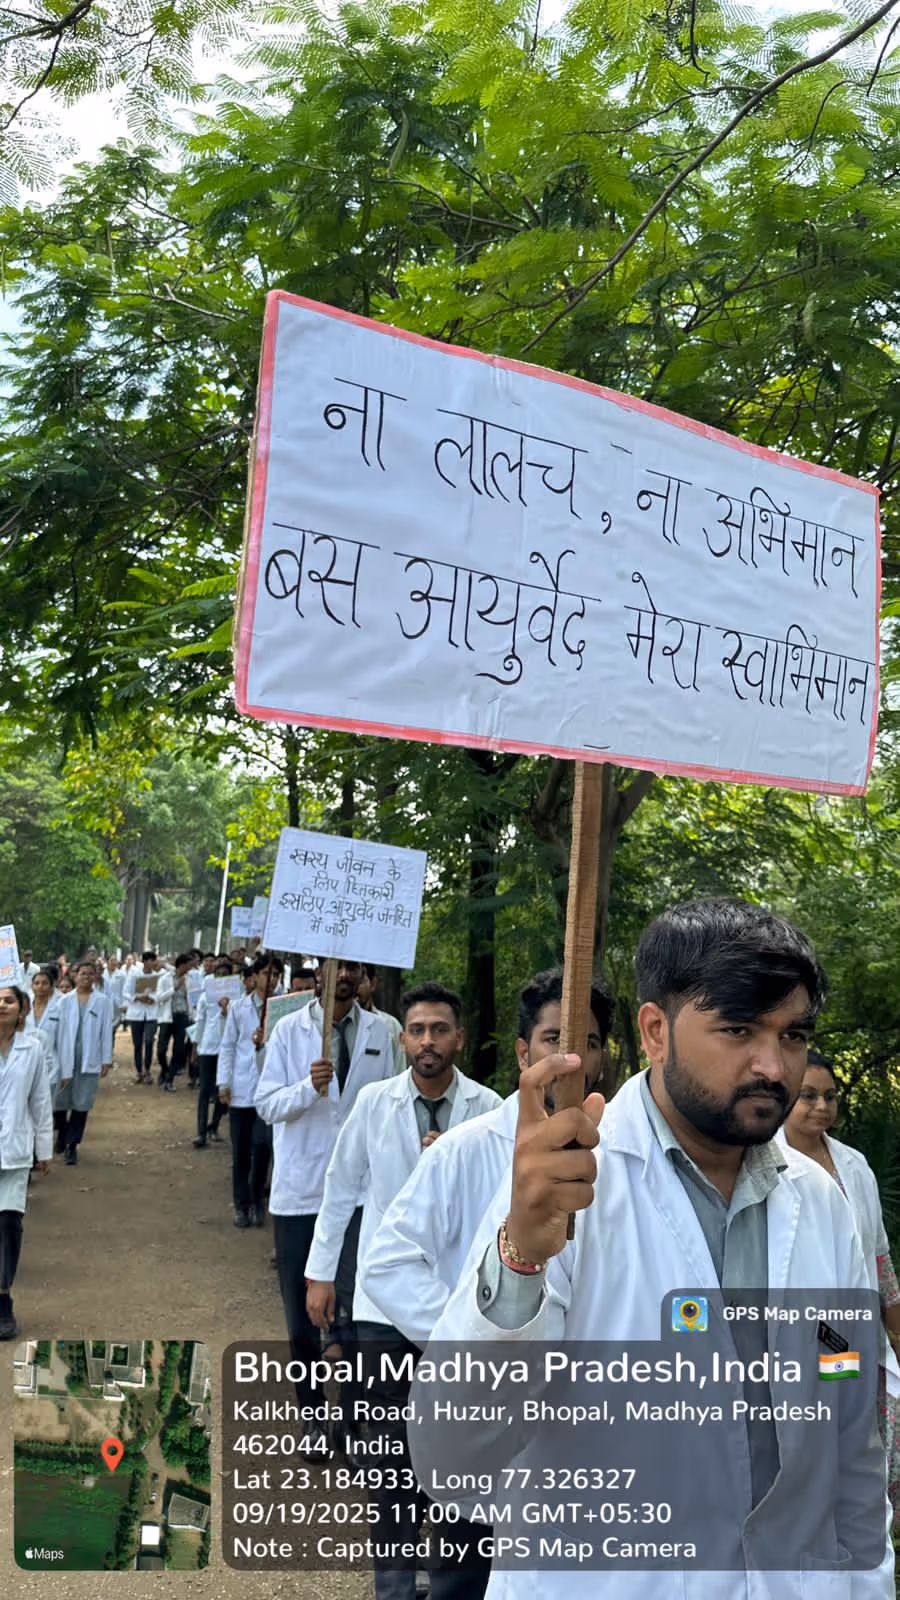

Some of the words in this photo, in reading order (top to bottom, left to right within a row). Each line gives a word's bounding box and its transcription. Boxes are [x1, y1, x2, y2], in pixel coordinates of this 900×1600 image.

[324, 377, 407, 471] ना
[636, 469, 693, 546] ना
[702, 487, 865, 598] अभिमान
[265, 522, 380, 628] बस
[394, 549, 602, 685] आयुर्वेद
[624, 571, 711, 692] मेरा
[715, 624, 876, 725] स्वाभिमान
[336, 850, 376, 878] जीवन
[387, 858, 401, 880] के
